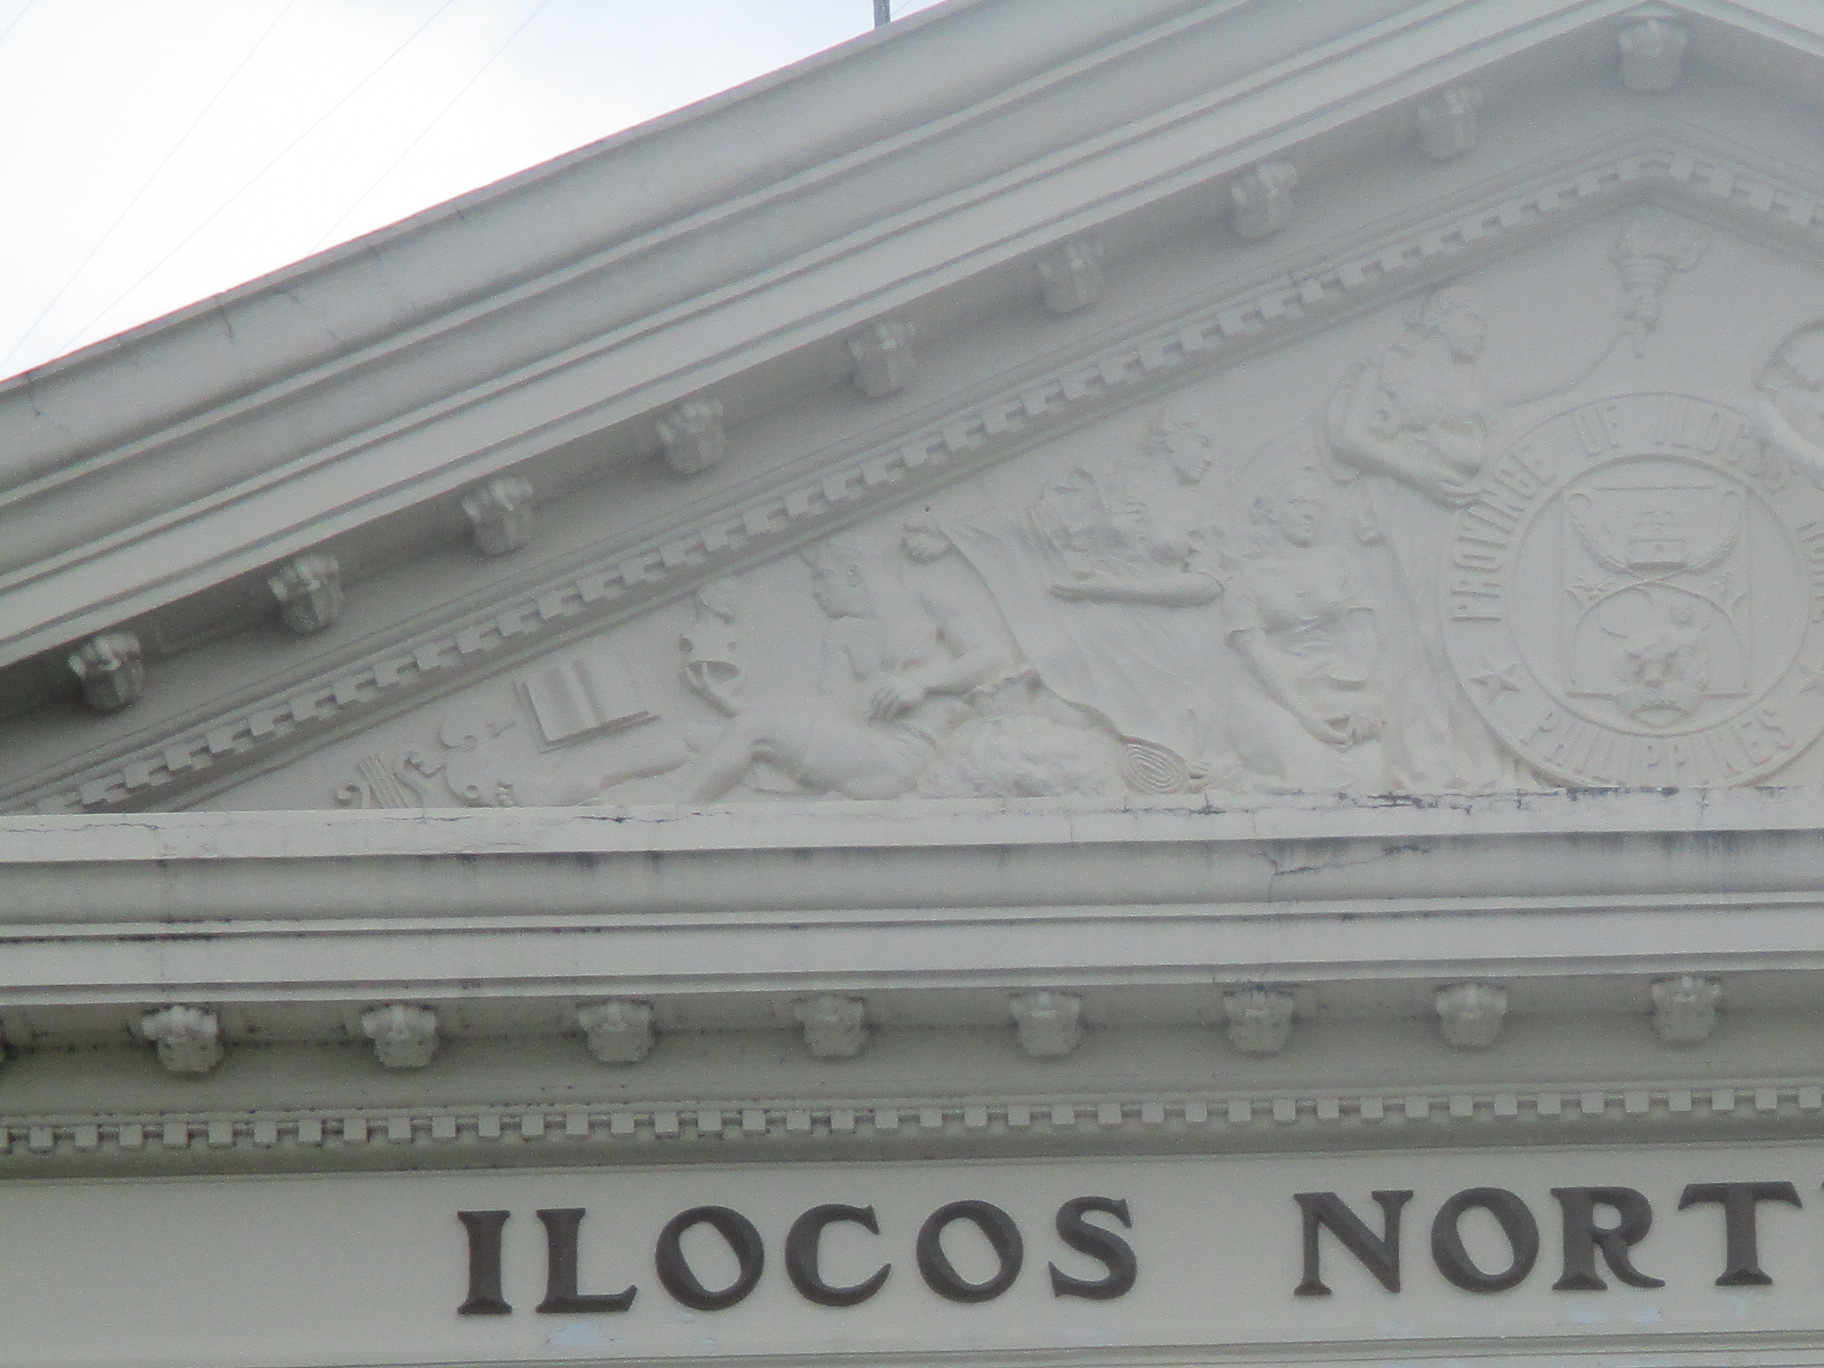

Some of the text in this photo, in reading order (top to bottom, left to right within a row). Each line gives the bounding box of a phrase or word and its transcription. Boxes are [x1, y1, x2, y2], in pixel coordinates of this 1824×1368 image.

[1449, 445, 1559, 624] PROVINCE
[1572, 404, 1621, 457] OF
[1654, 402, 1796, 495] ILOCOS
[1519, 708, 1797, 787] PHILIPPINES
[456, 1196, 1138, 1318] ILOCOS
